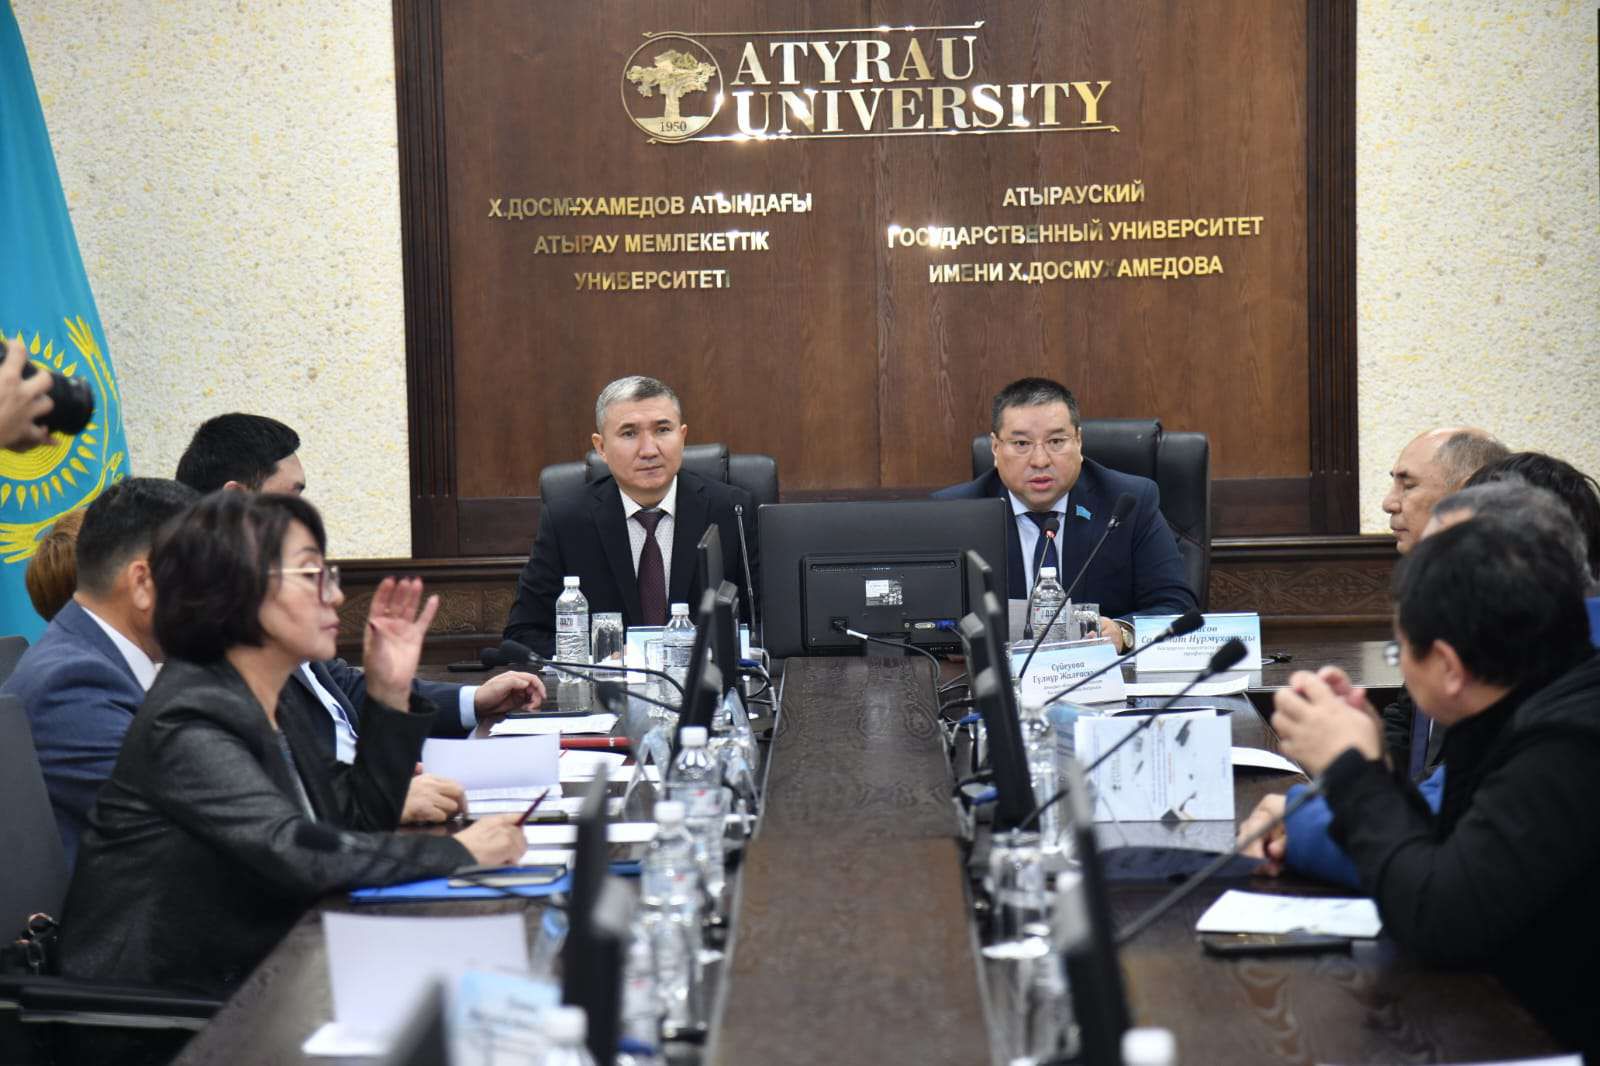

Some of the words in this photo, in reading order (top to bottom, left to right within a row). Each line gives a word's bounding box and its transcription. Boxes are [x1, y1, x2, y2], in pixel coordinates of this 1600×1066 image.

[730, 36, 977, 86] ATYRAU
[732, 80, 1113, 136] UNIVERSITY
[660, 120, 687, 132] 1950
[690, 191, 812, 217] АТЫНДАҒЫ
[1002, 180, 1145, 207] АТЫРАУСКИЙ
[533, 234, 619, 255] АТЫРАУ
[625, 230, 770, 253] МЕМЛЕКЕТТІК
[887, 218, 1104, 250] ГОСУДАРСТВЕННЫЙ
[1109, 216, 1264, 242] УНИВЕРСИТЕТ
[575, 269, 731, 291] УНИВЕРСИТЕТІ
[929, 260, 1003, 283] ИМЕНИ
